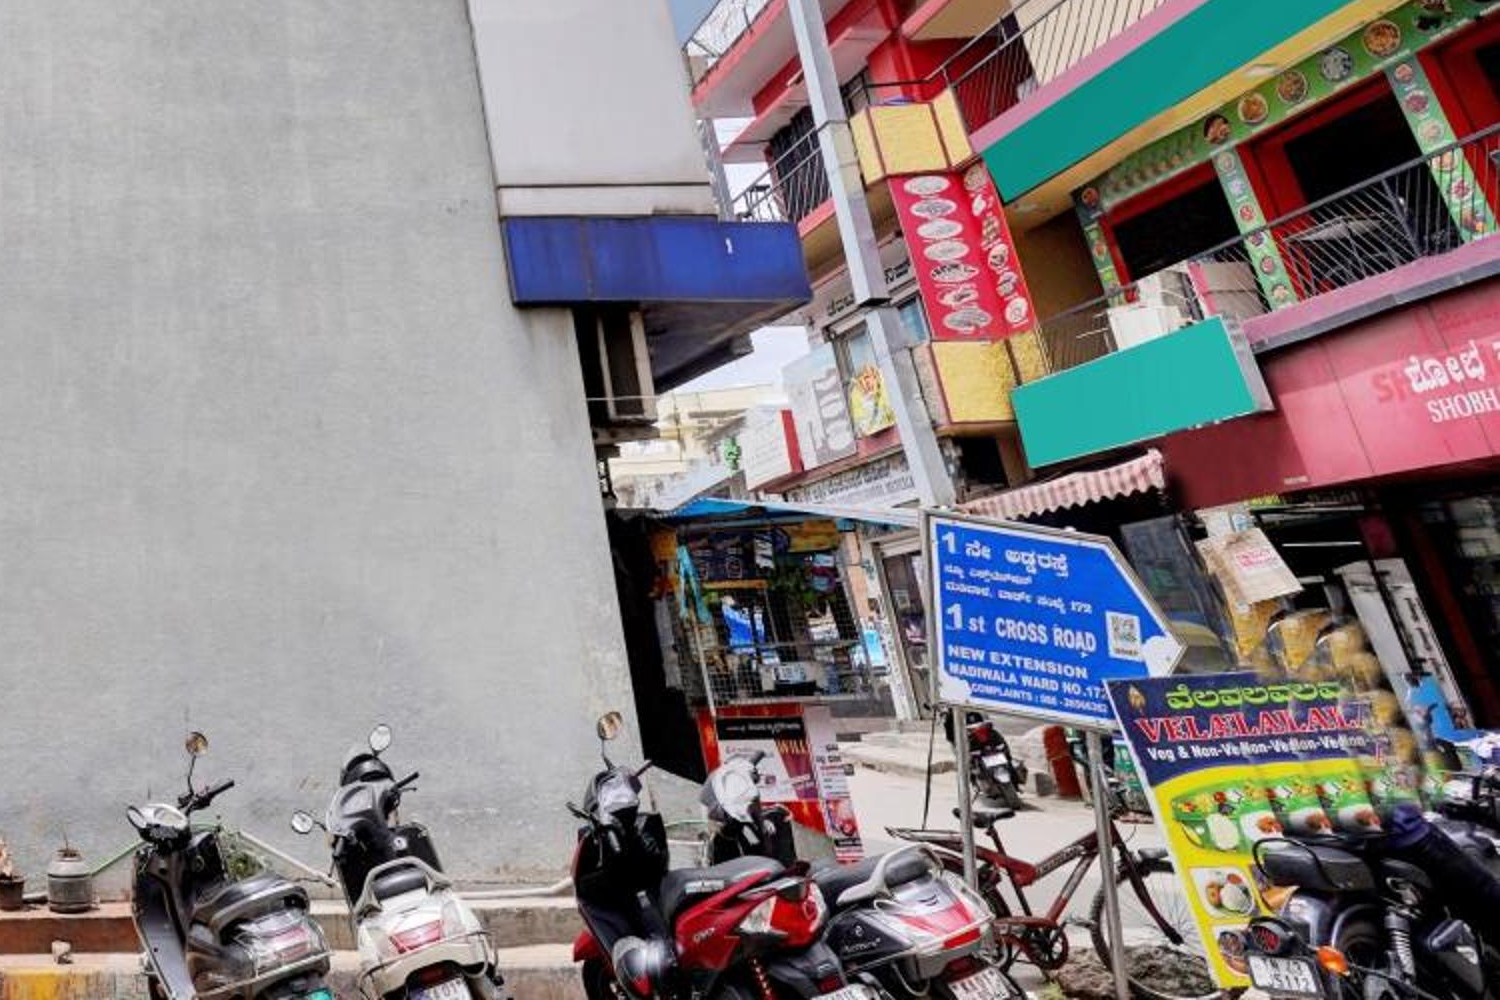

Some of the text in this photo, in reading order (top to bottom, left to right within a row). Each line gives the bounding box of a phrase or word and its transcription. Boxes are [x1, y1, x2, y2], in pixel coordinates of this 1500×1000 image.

[942, 532, 956, 554] 1
[947, 603, 1097, 652] 1 st CROSS ROAD
[948, 645, 1088, 679] NEW EXTENSION
[949, 662, 1017, 685] MADIWALA
[1021, 675, 1059, 693] WARD
[971, 683, 1033, 702] COMPLAINTS
[1148, 746, 1175, 762] Veg
[1178, 745, 1190, 759] &
